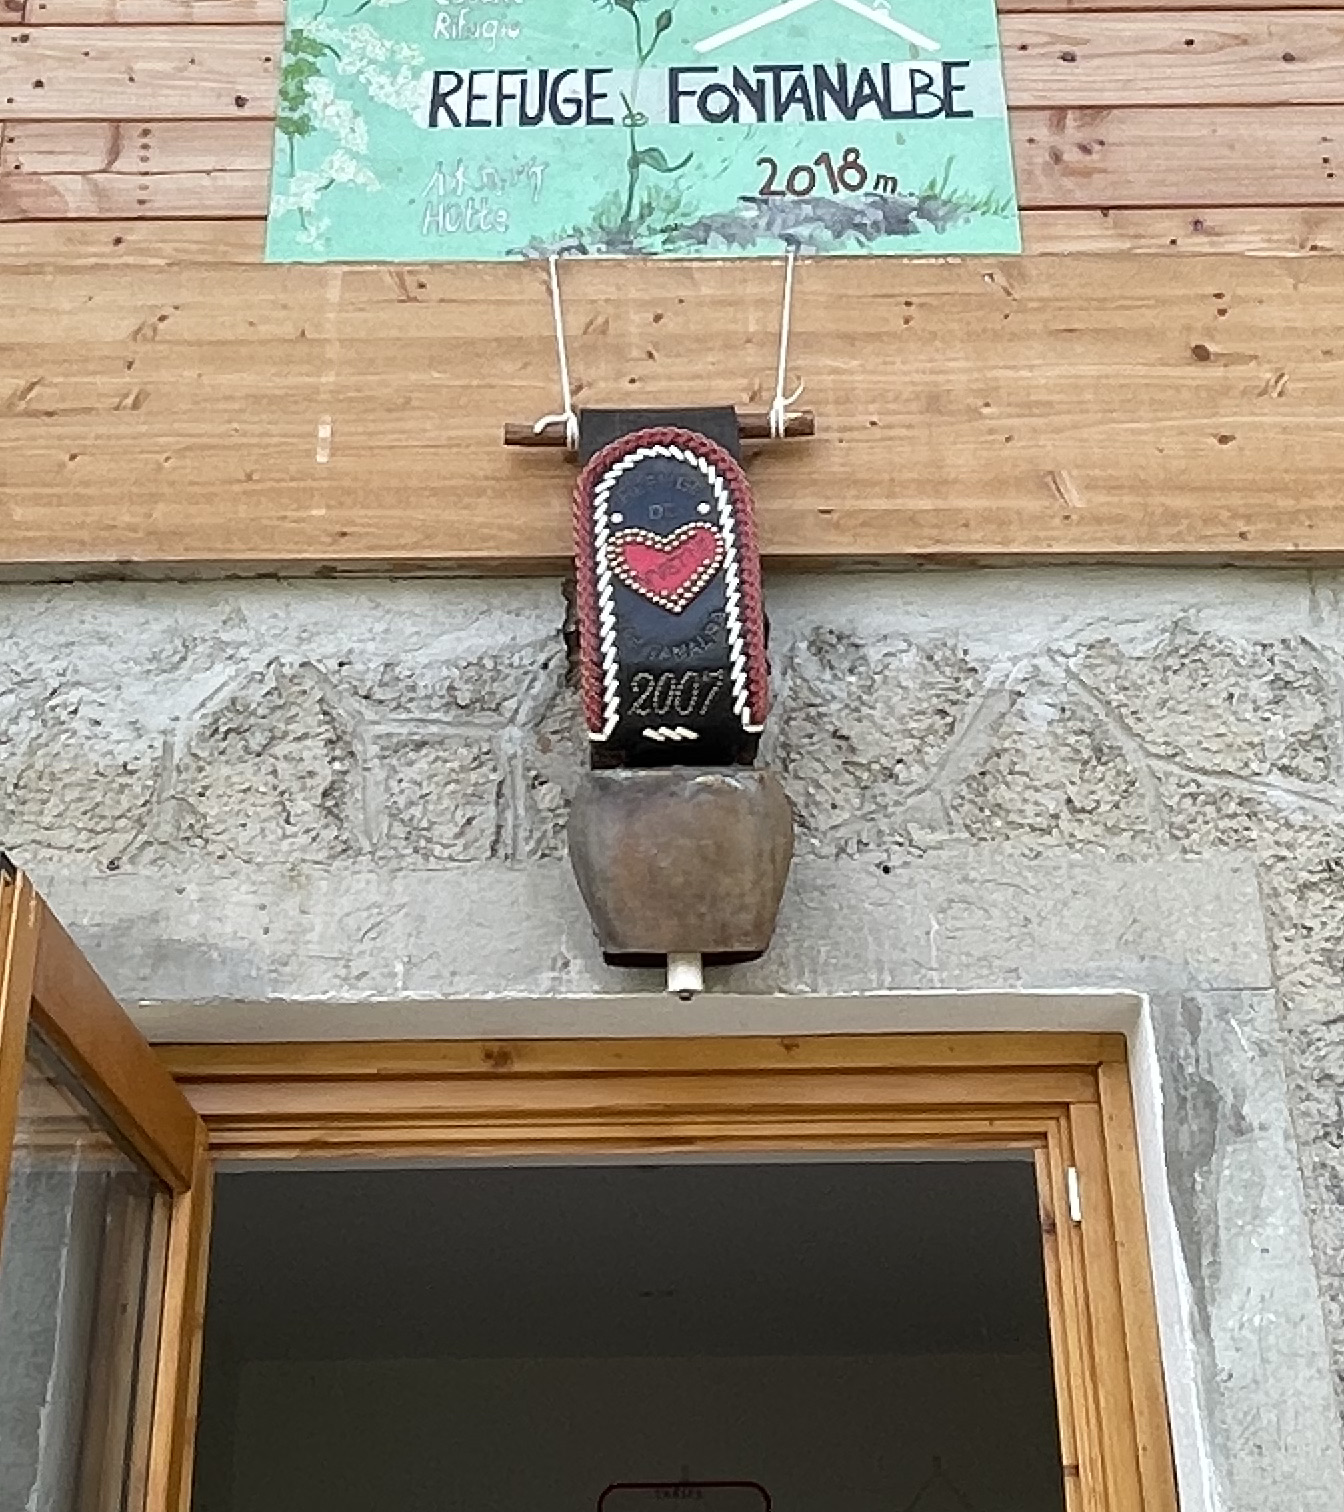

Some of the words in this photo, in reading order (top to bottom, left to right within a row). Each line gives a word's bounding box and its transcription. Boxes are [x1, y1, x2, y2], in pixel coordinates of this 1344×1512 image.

[433, 7, 521, 53] Rifugio
[428, 67, 615, 128] REFUGE
[667, 60, 974, 125] FONTANALBE
[756, 146, 868, 197] 2018
[626, 668, 725, 716] 2007
